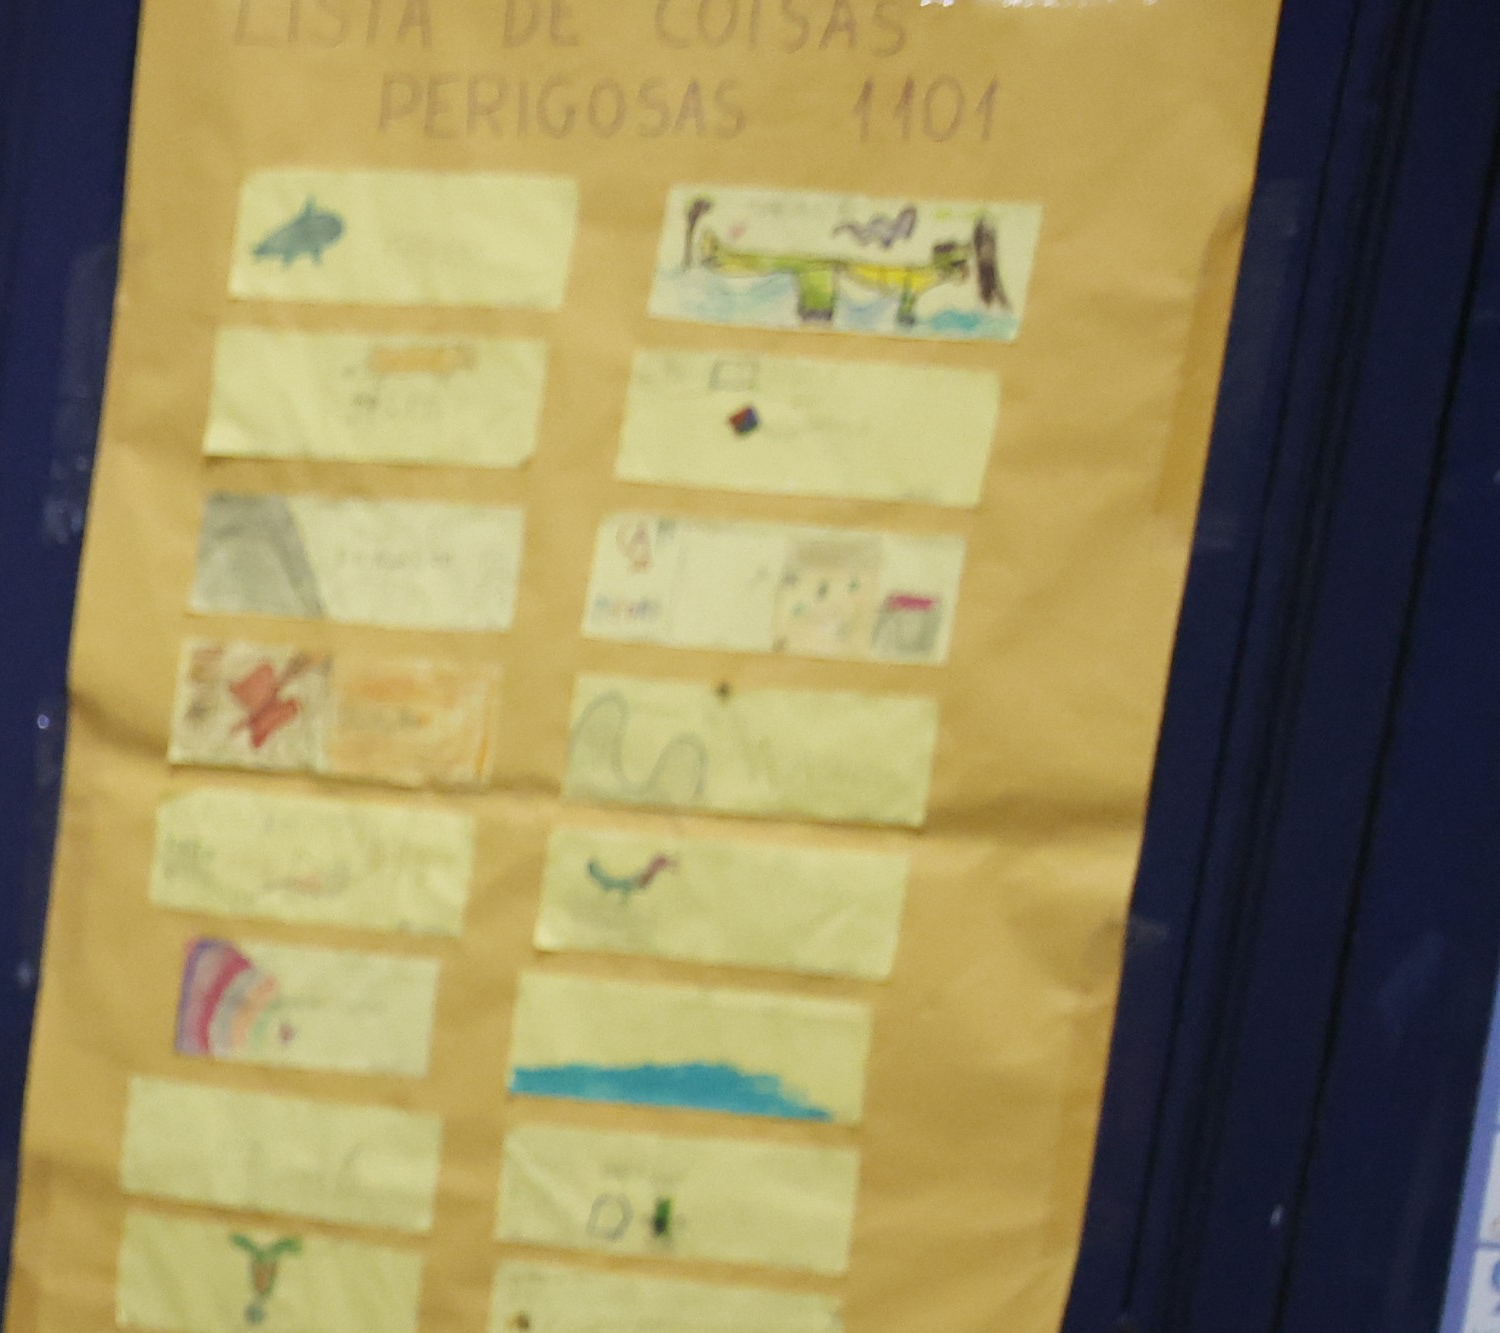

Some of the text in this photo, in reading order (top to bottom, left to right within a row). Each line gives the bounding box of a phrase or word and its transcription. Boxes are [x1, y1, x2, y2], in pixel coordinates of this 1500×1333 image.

[500, 0, 581, 49] DE
[653, 0, 913, 58] COISAS
[378, 71, 1000, 143] PERIGOSAS 1101
